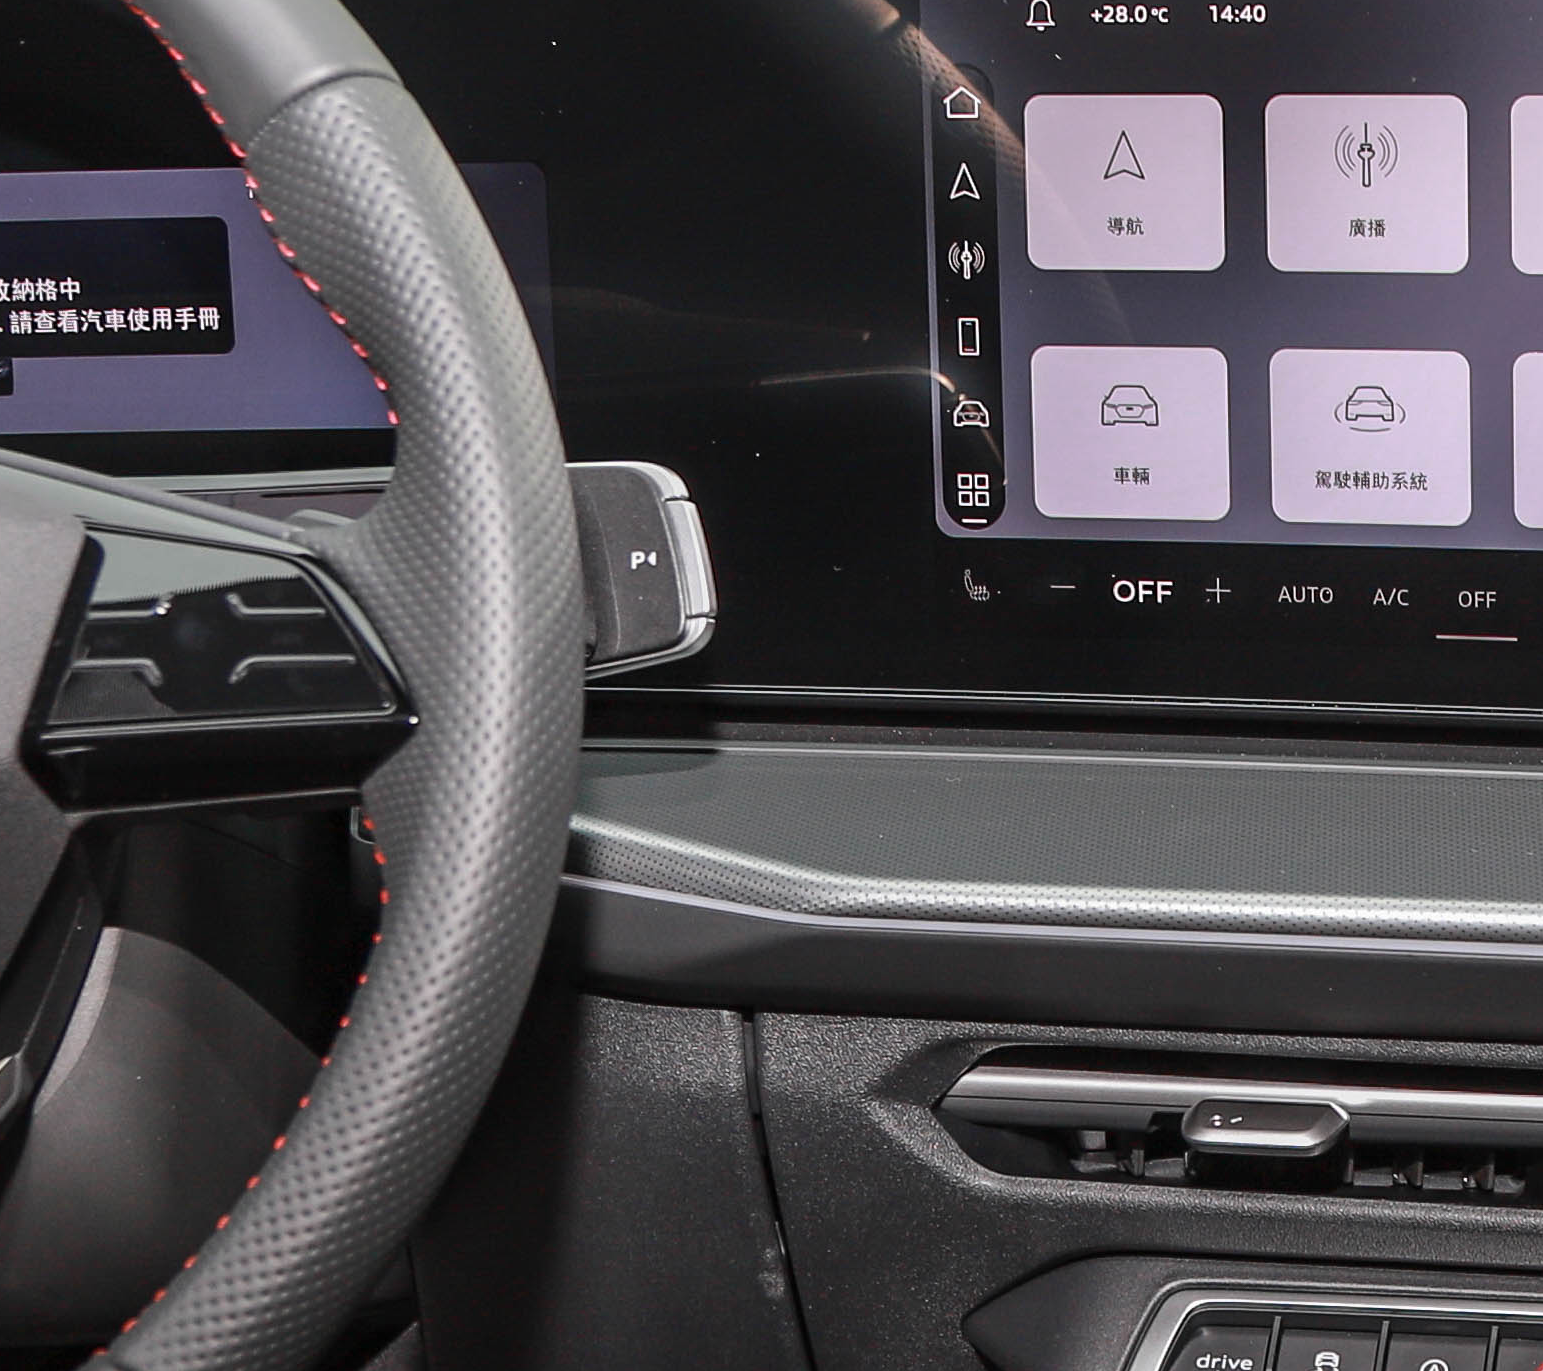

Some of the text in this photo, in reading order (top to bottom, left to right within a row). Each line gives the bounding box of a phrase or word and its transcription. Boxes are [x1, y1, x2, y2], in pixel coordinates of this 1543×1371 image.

[1208, 4, 1267, 24] 14:40
[1107, 217, 1145, 237] 導航
[1349, 218, 1386, 238] 廣播
[1114, 466, 1150, 487] 車輛
[1315, 469, 1429, 492] 駕駛輔助系統
[1112, 579, 1174, 604] OFF
[1277, 585, 1335, 605] AUTO
[1372, 587, 1410, 607] A/C
[1458, 590, 1497, 610] OFF
[1195, 1353, 1254, 1371] drive
